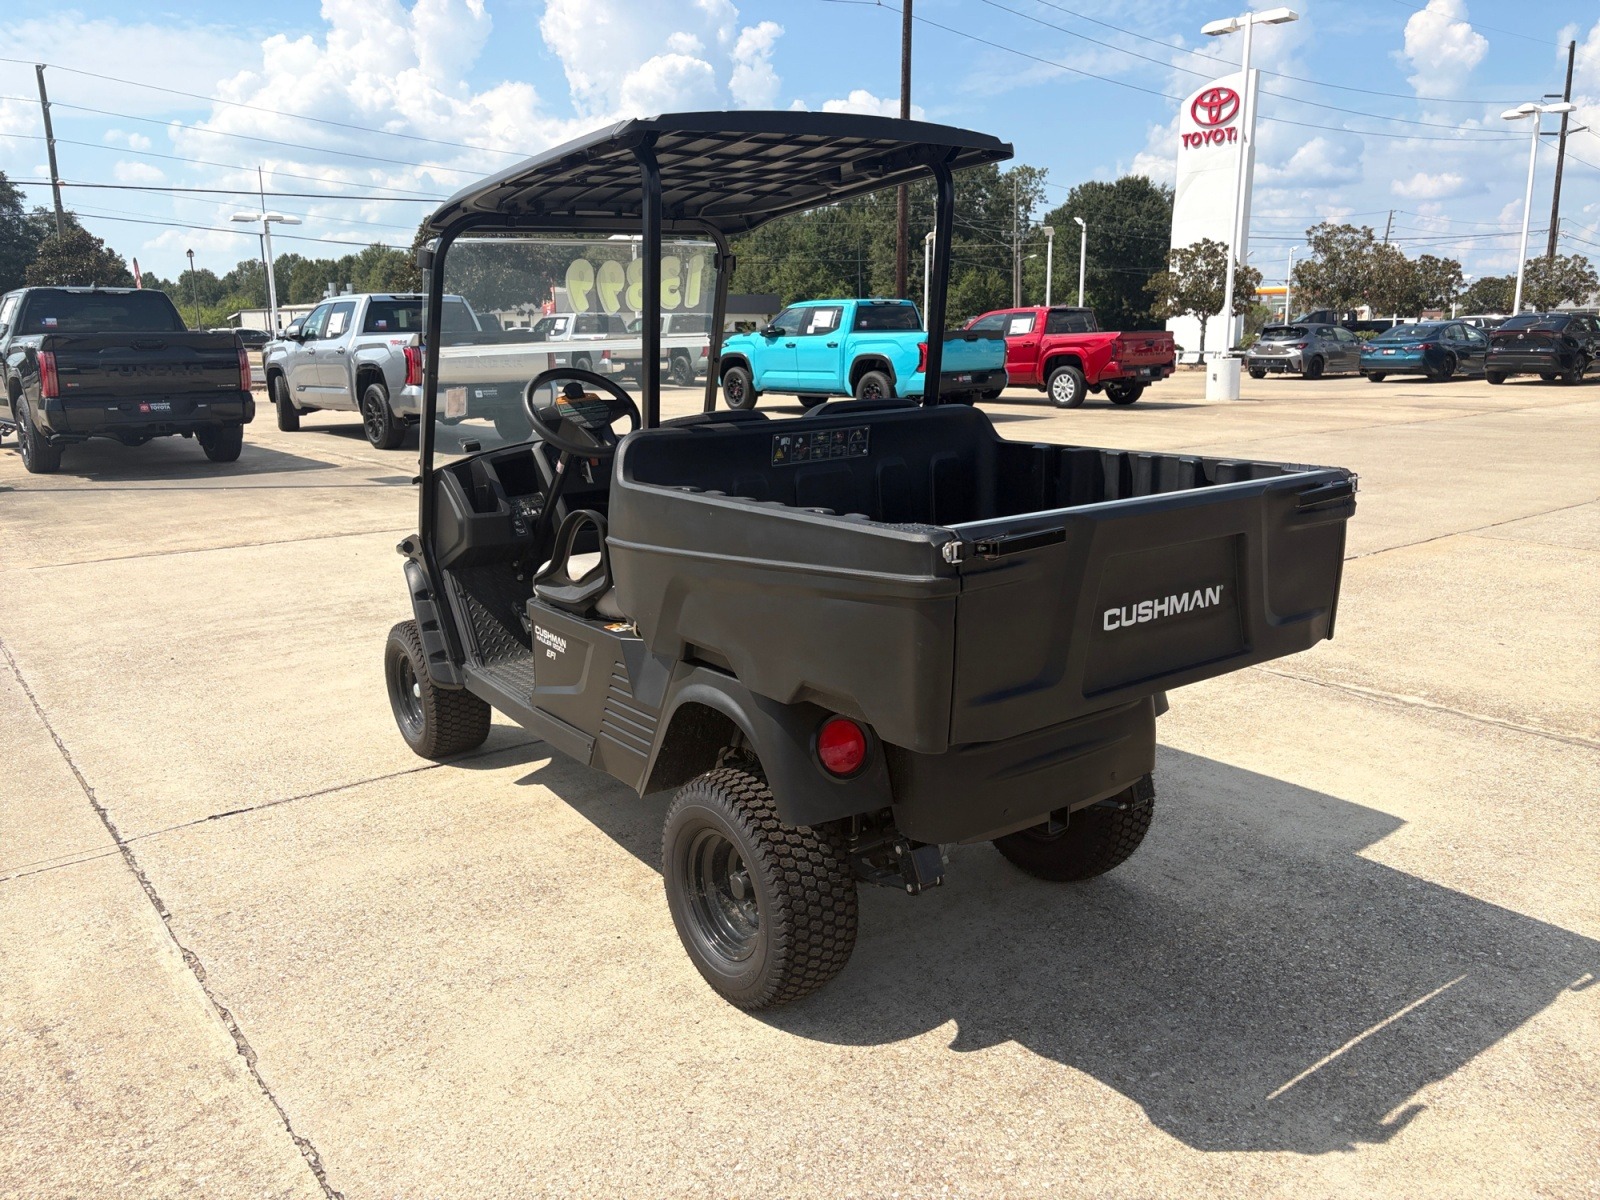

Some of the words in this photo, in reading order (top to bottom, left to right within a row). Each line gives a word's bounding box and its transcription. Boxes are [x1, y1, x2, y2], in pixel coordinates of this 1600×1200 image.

[1182, 127, 1240, 148] TOYOT
[104, 364, 203, 377] TUNDRA
[1103, 585, 1220, 631] CUSHMAN
[534, 624, 567, 649] CUSHMAN
[546, 648, 557, 661] EFI
